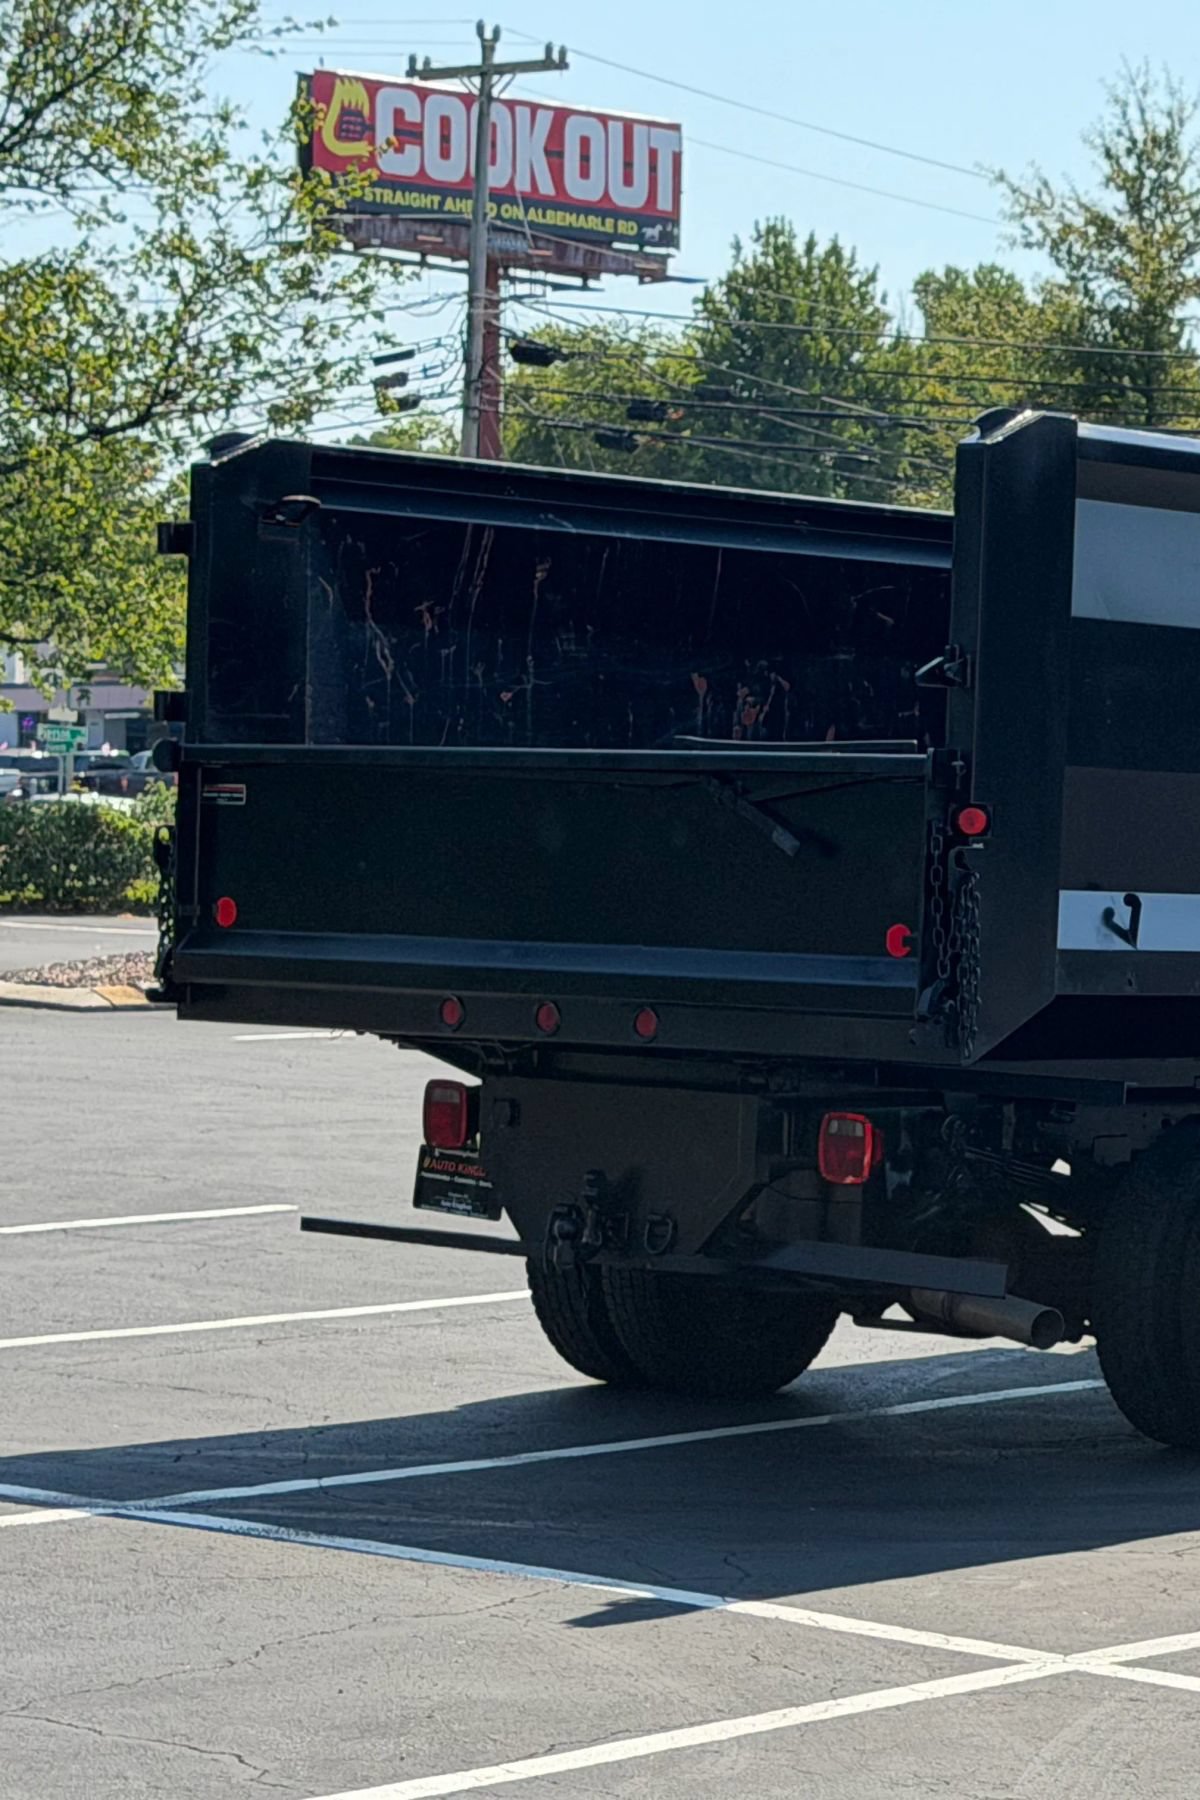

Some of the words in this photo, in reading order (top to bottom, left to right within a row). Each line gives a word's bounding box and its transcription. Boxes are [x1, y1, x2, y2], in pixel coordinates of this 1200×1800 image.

[375, 87, 556, 196] COOK
[564, 115, 681, 212] OUT
[364, 187, 441, 210] STRAIGHT
[443, 197, 497, 218] AHED
[501, 203, 524, 220] ON
[528, 207, 614, 233] ALBEMARLE
[617, 221, 638, 236] RD
[430, 1159, 456, 1172] AUTO
